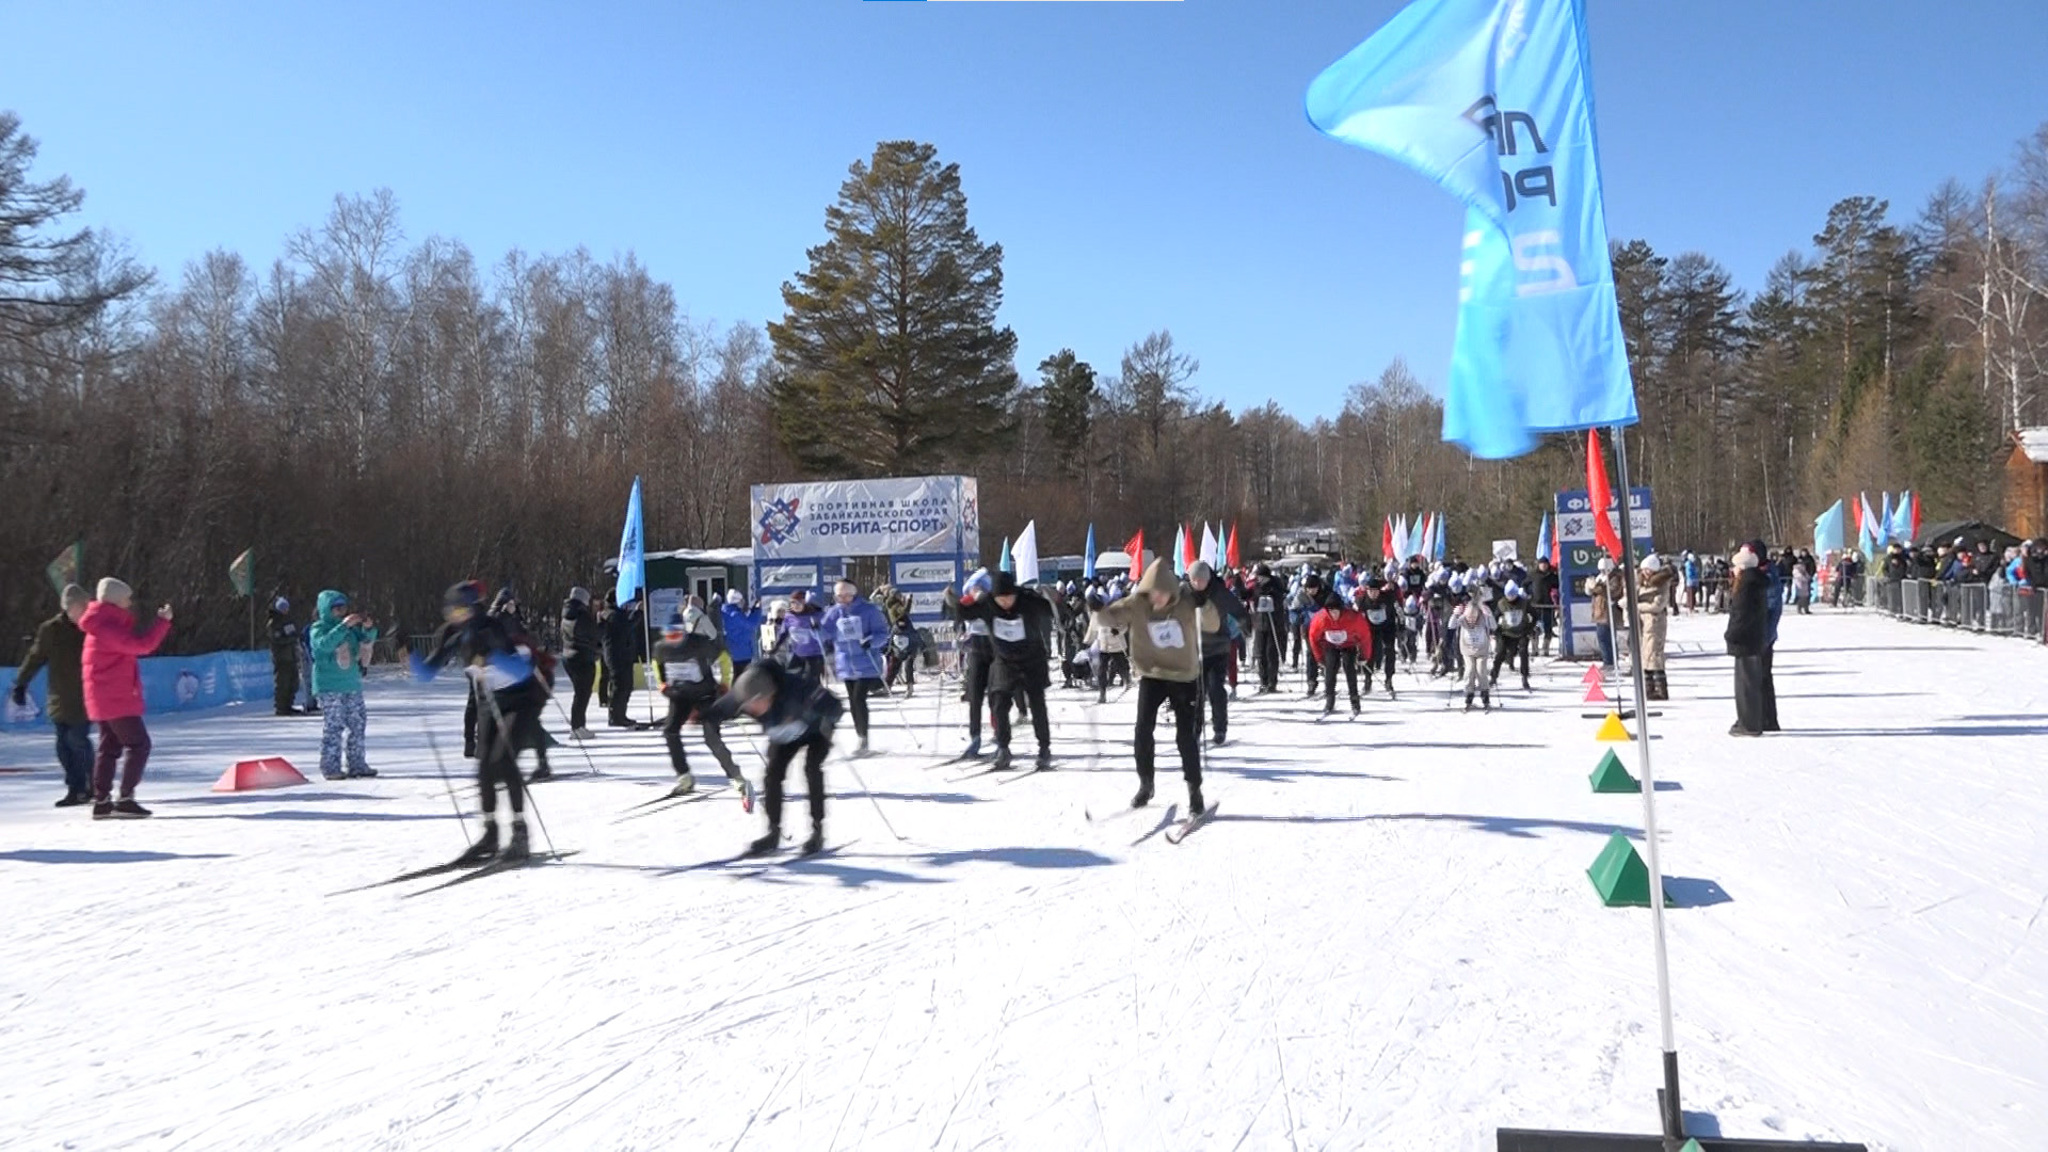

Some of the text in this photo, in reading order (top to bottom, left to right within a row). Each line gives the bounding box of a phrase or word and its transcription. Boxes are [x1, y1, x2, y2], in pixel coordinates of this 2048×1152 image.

[809, 497, 948, 511] СПОРТИВНАЯ ШКОЛА
[1567, 494, 1641, 510] ФИИШ
[809, 507, 948, 521] ЗАБАЙКАЛЬСКОГО КРАЯ
[810, 518, 948, 535] «ОРБИТА-СПОРТ»
